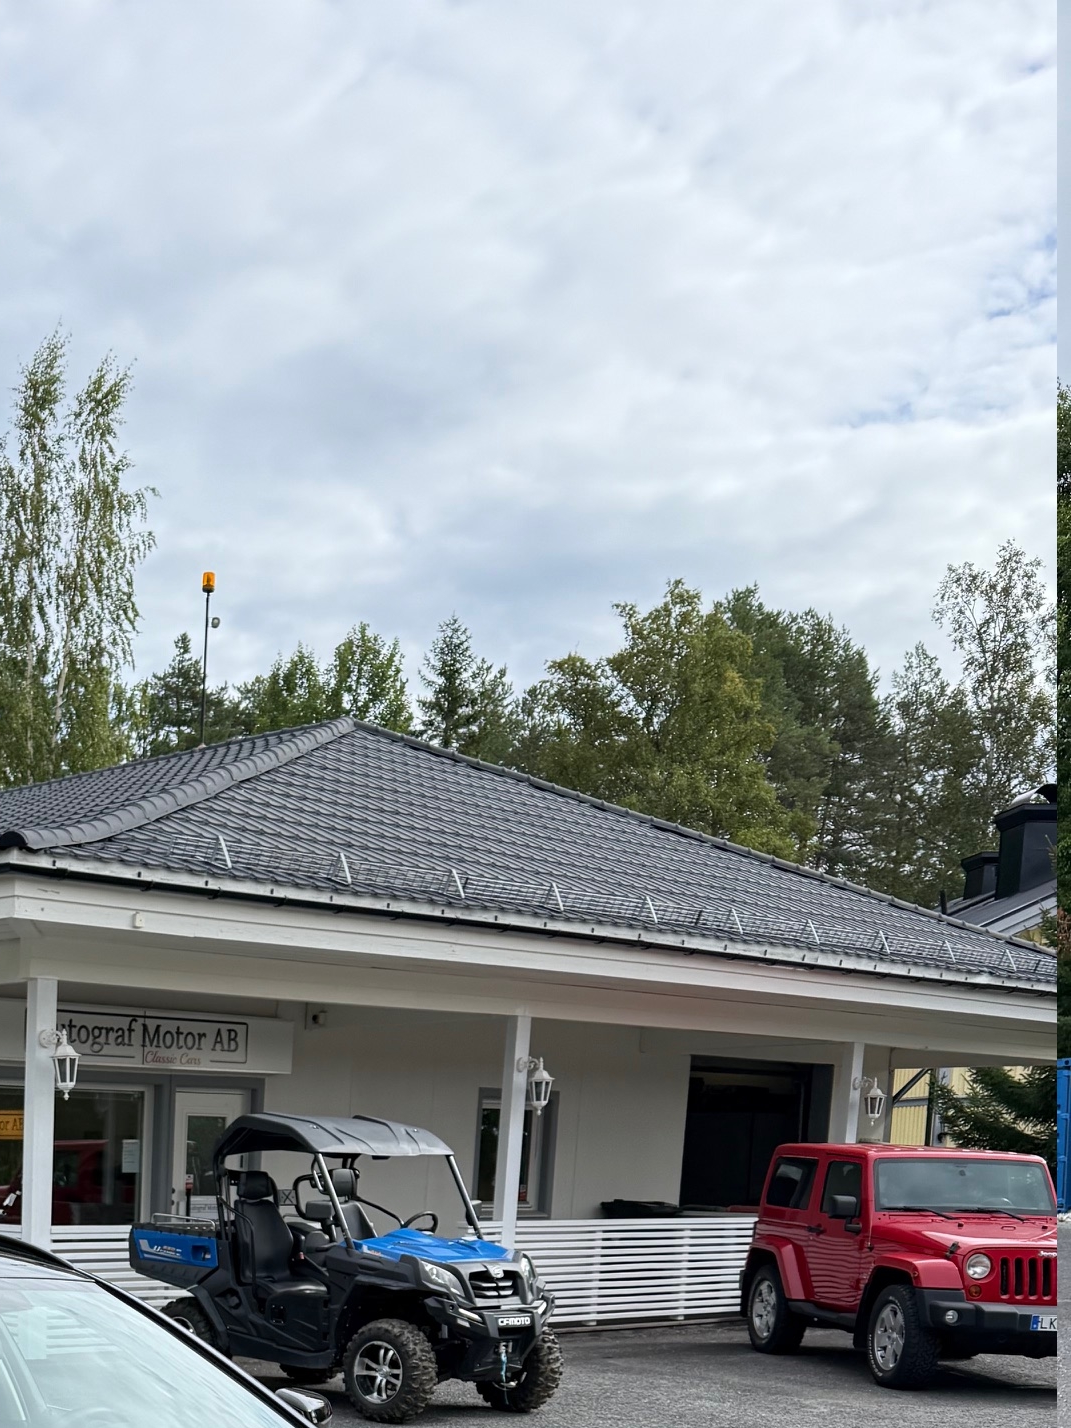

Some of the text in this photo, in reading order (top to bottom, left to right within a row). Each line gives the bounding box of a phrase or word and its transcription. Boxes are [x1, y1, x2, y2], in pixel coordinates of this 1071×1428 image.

[141, 1022, 207, 1051] Motor
[211, 1027, 240, 1053] AB
[144, 1050, 201, 1065] Classic Cars
[498, 1317, 531, 1326] CFMOTO
